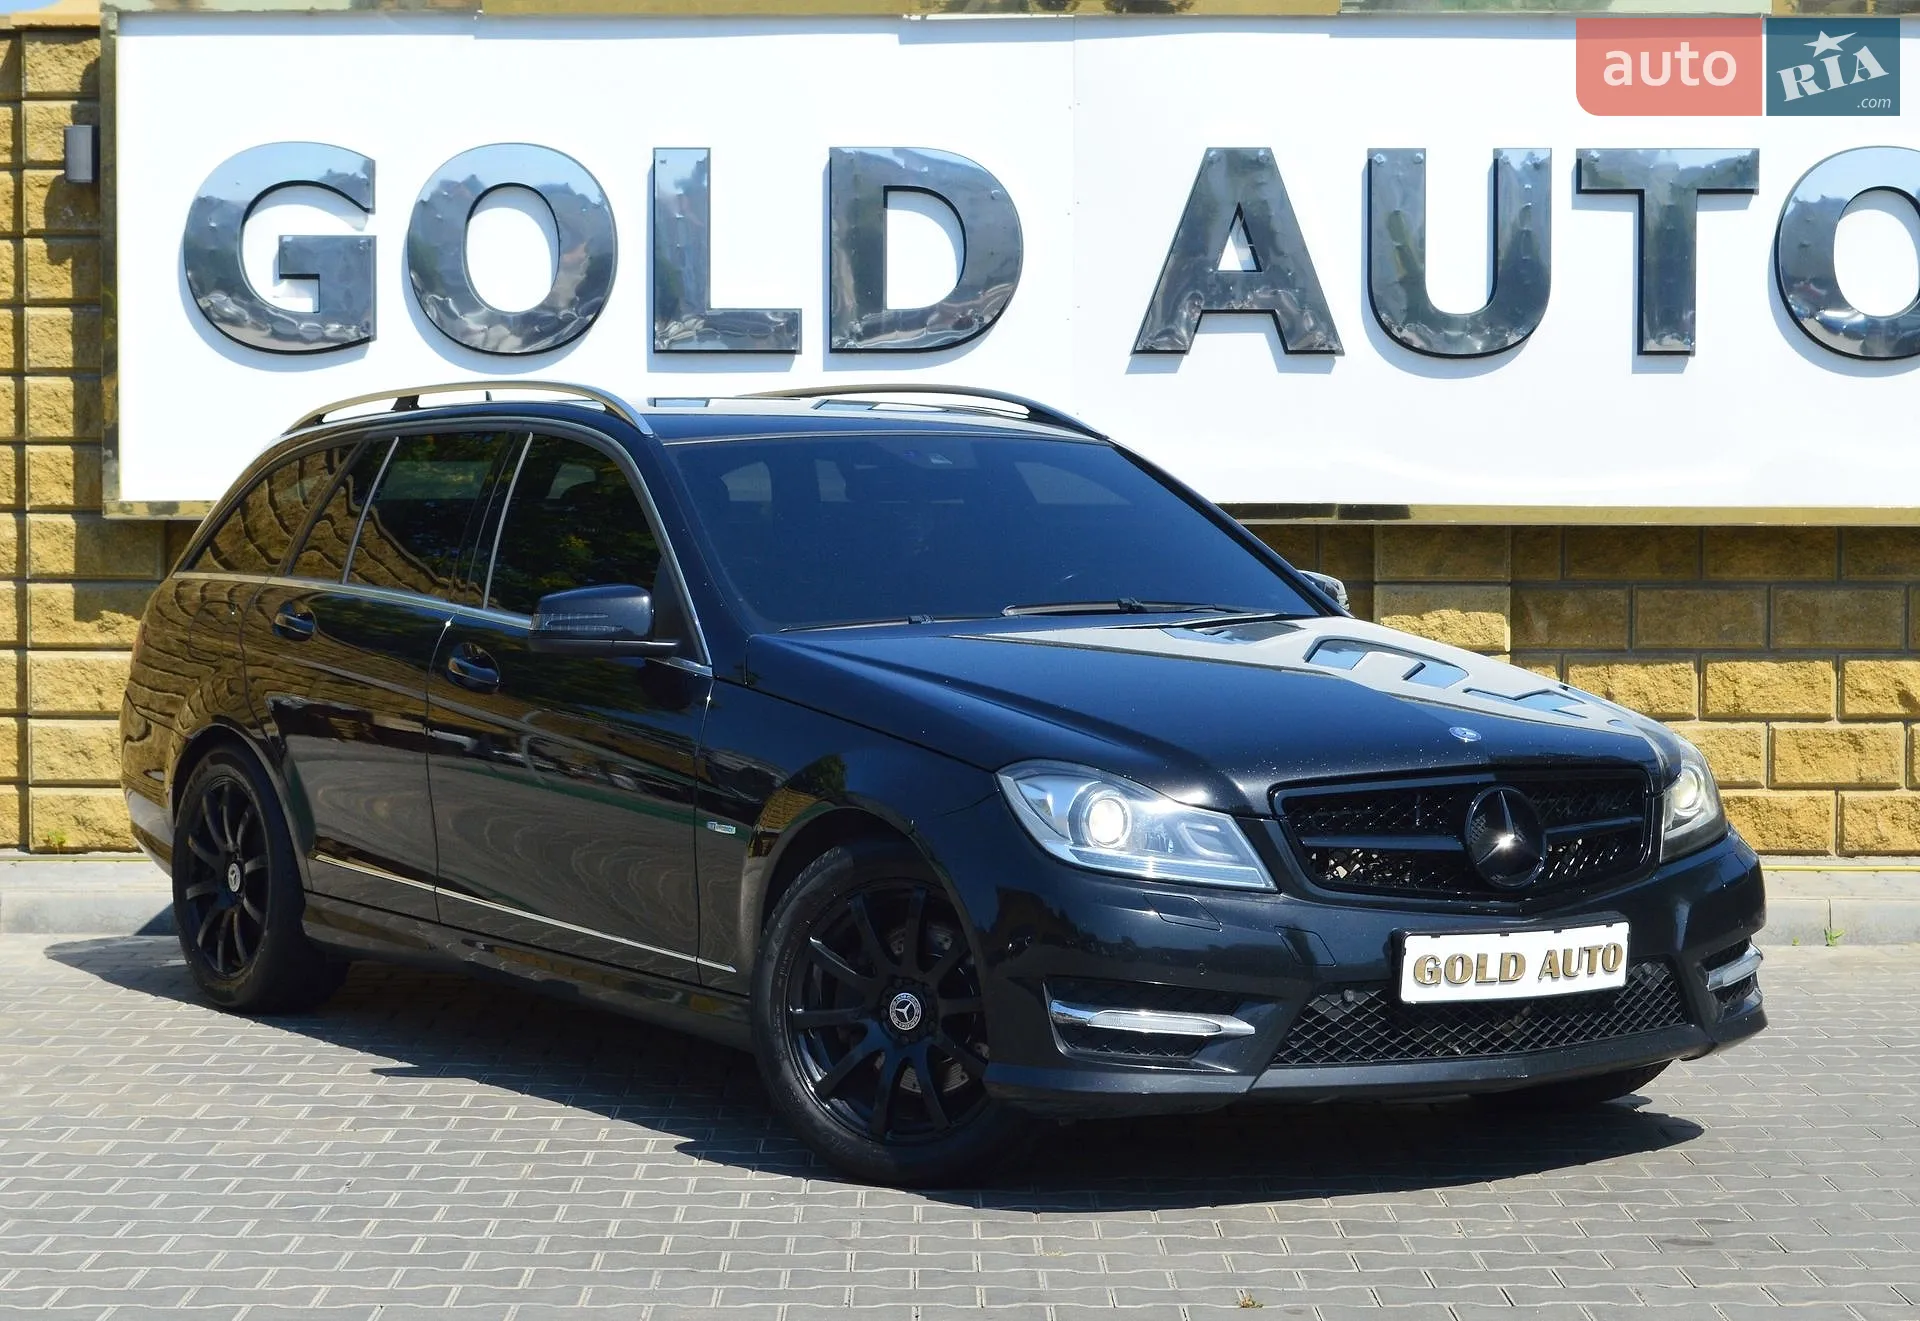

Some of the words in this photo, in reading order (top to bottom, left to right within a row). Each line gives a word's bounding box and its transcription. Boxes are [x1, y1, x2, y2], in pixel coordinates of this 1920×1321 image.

[183, 141, 1024, 356] GOLD
[1131, 146, 1920, 360] AUTO
[1413, 953, 1526, 985] GOLD
[1538, 943, 1623, 980] AUTO
